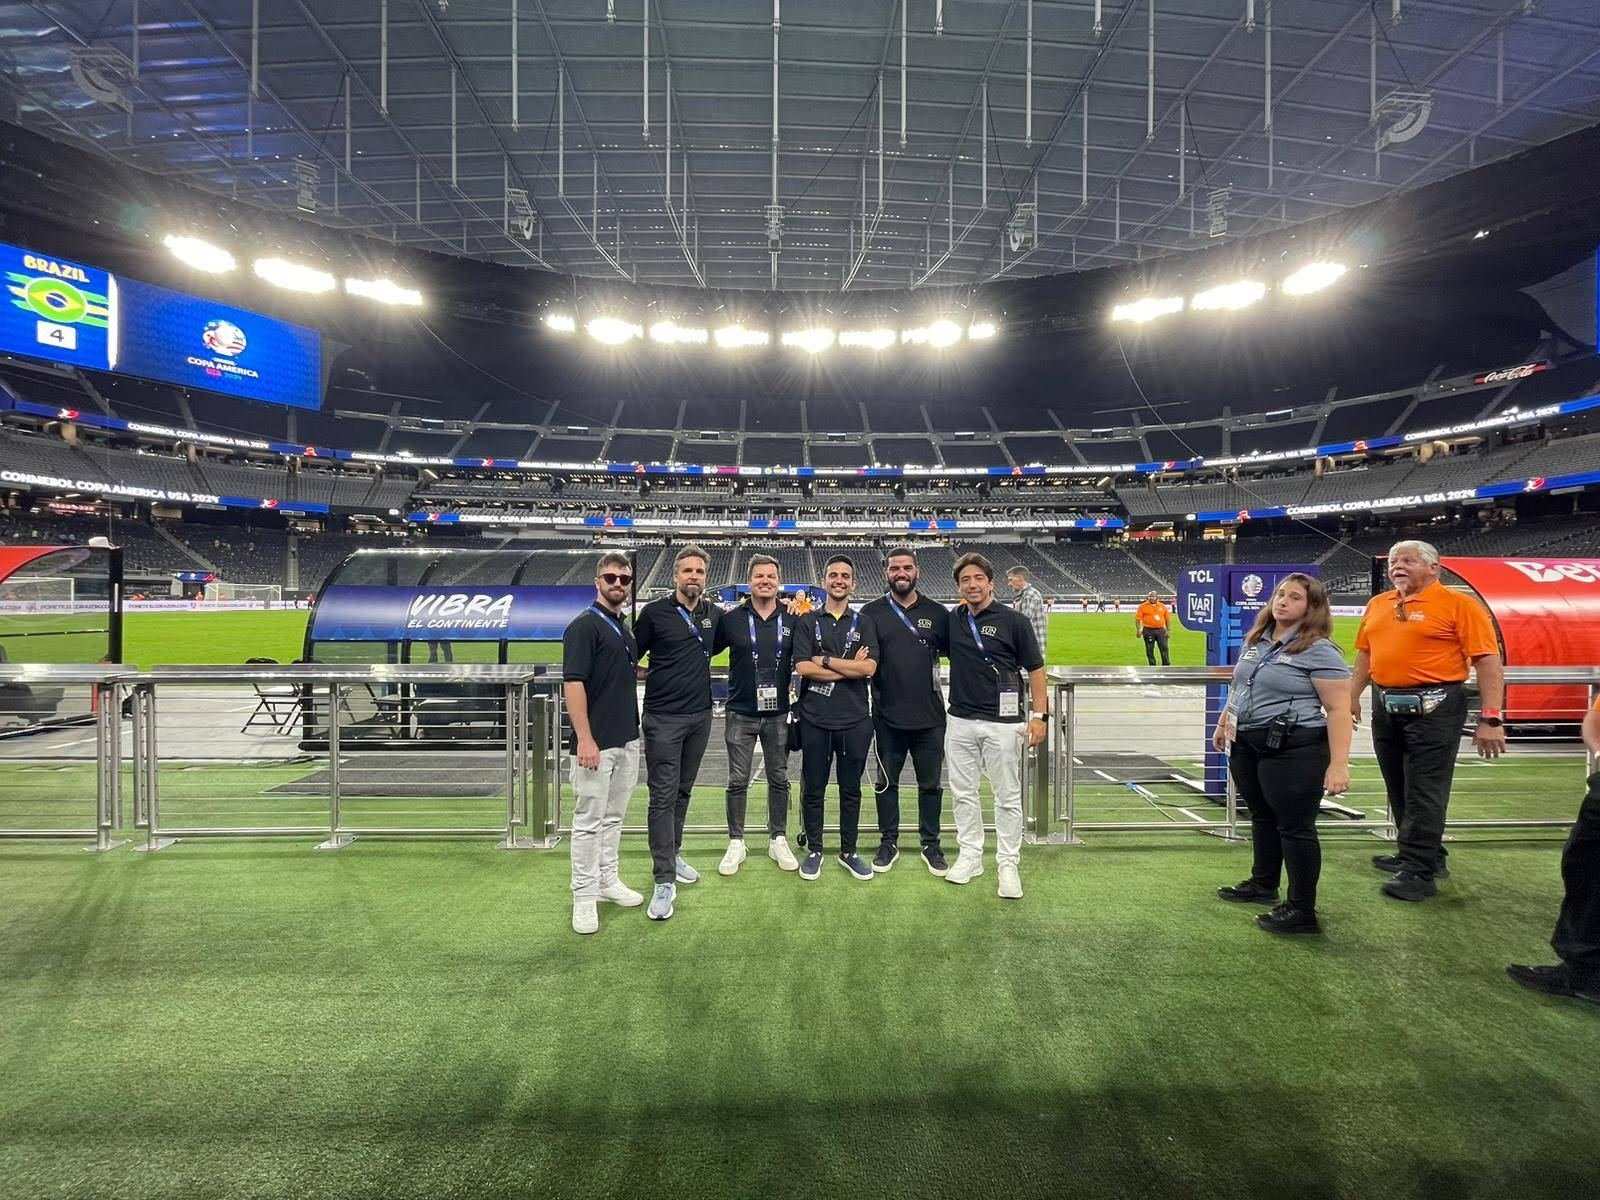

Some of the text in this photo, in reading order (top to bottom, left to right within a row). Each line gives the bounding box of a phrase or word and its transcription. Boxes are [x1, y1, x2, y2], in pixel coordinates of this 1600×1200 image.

[24, 255, 90, 283] BRAZIL
[50, 329, 65, 342] 4
[188, 357, 215, 369] COPA
[216, 363, 259, 378] AMERICA
[1452, 423, 1477, 433] COPA
[177, 430, 200, 440] COPA
[1, 470, 220, 504] CONMEBOL COPA AMERICA USA 2024
[1287, 488, 1477, 515] CONMEBOL COPA AMERICA USA 2024
[1188, 570, 1215, 583] TCL
[410, 594, 514, 616] VIBRA
[1191, 598, 1211, 611] VAR
[408, 619, 508, 628] EL CONTINENTE
[918, 619, 932, 627] SUN
[981, 625, 997, 635] SUN
